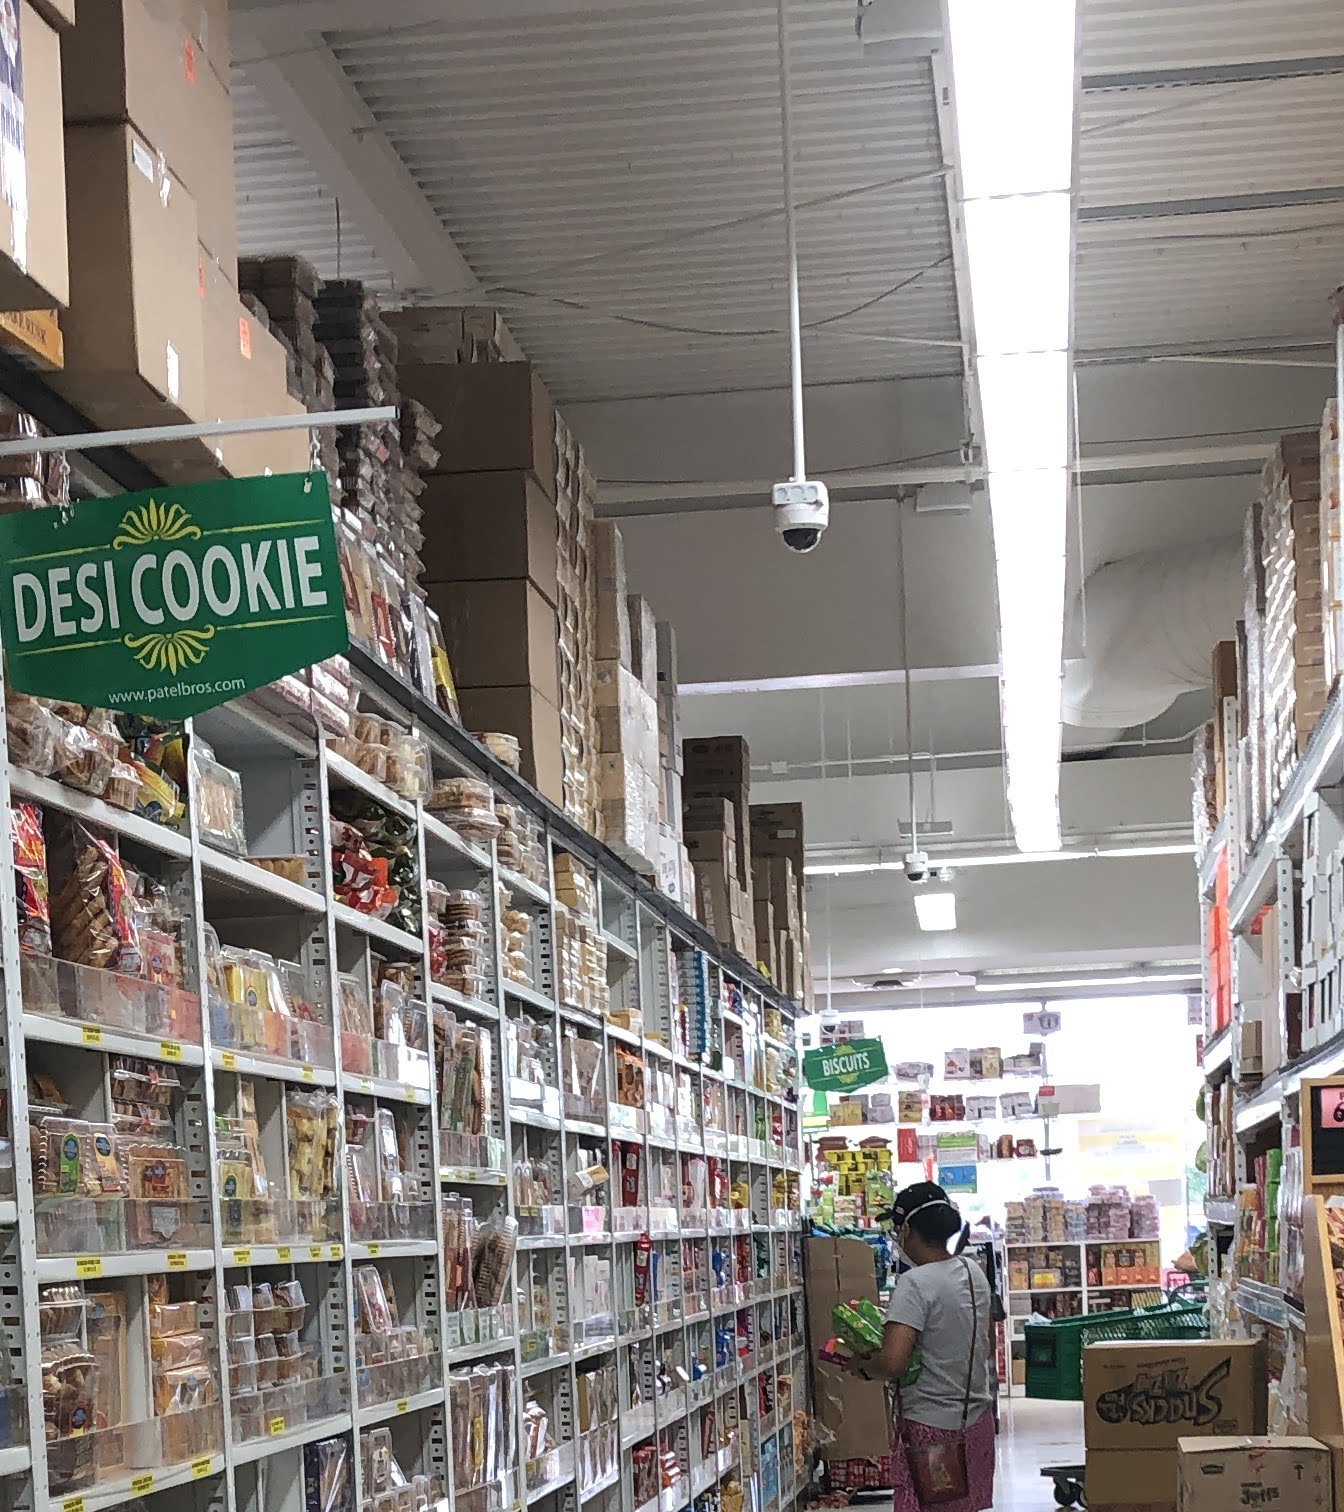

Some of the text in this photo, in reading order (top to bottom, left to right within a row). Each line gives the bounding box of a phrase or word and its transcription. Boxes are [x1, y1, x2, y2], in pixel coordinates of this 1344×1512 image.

[12, 536, 328, 642] DESI COOKIE
[108, 676, 246, 704] www.patelbros.com
[822, 1052, 870, 1076] BISCUITS
